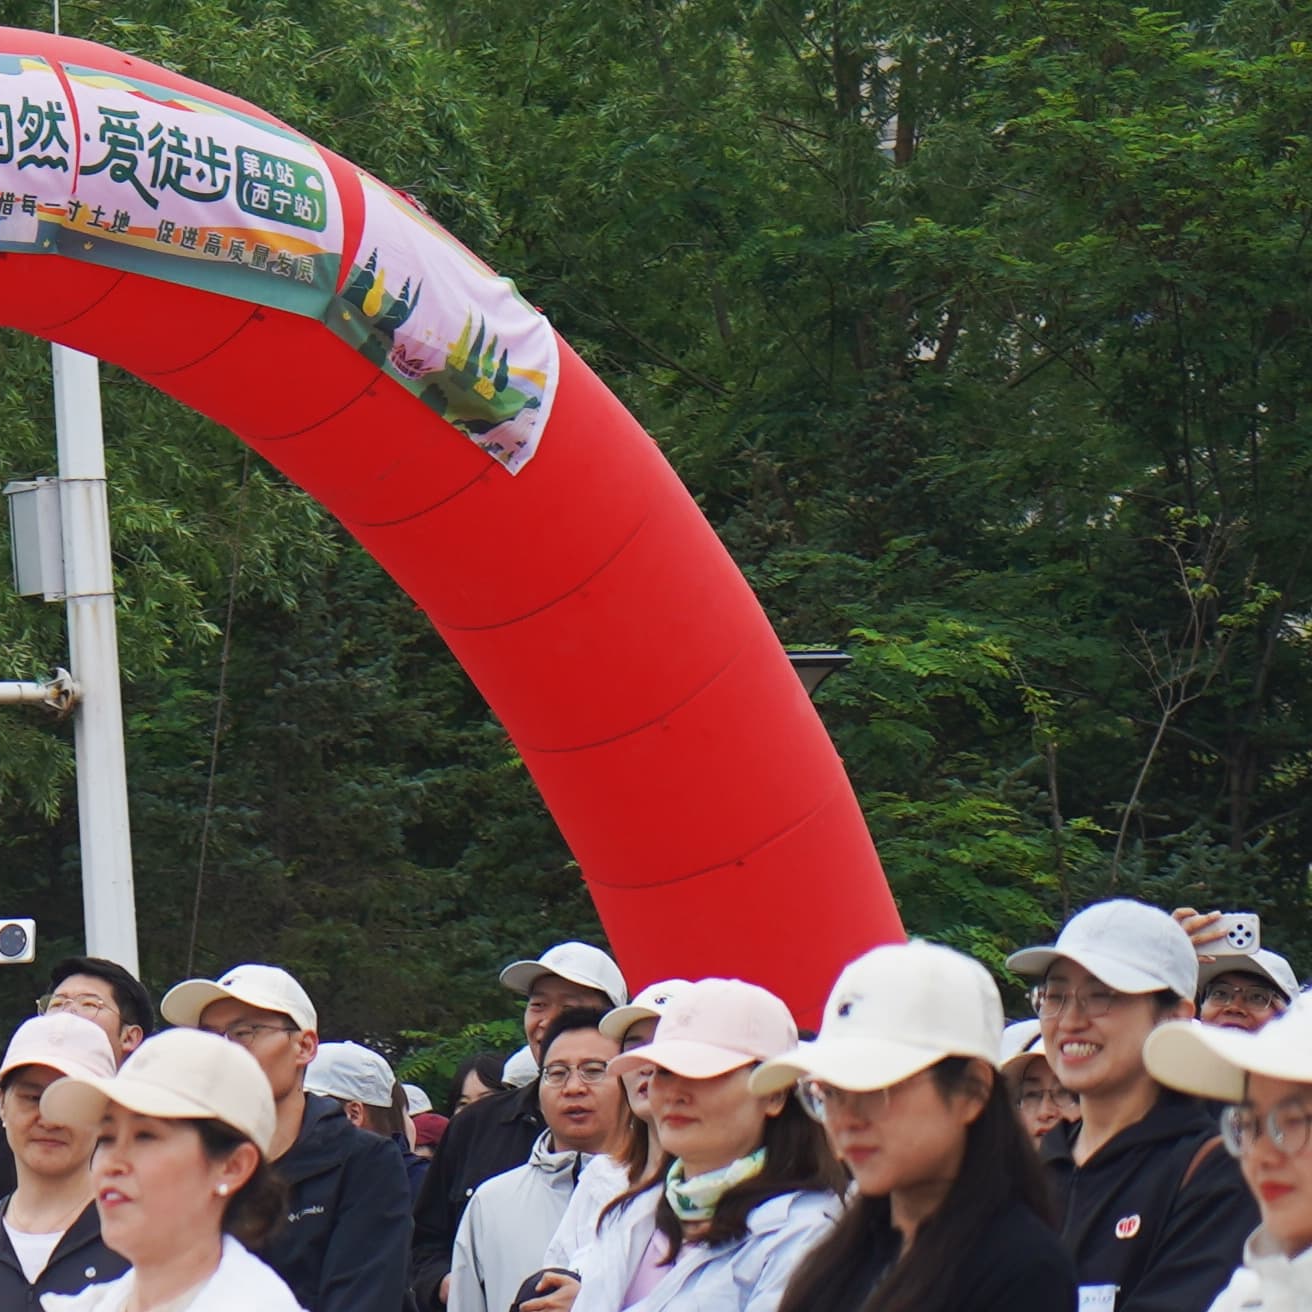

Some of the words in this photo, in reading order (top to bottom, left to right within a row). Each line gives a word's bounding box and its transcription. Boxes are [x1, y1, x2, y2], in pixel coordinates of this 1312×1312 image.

[242, 151, 296, 188] 第4站
[156, 219, 316, 284] 促进高质量发展
